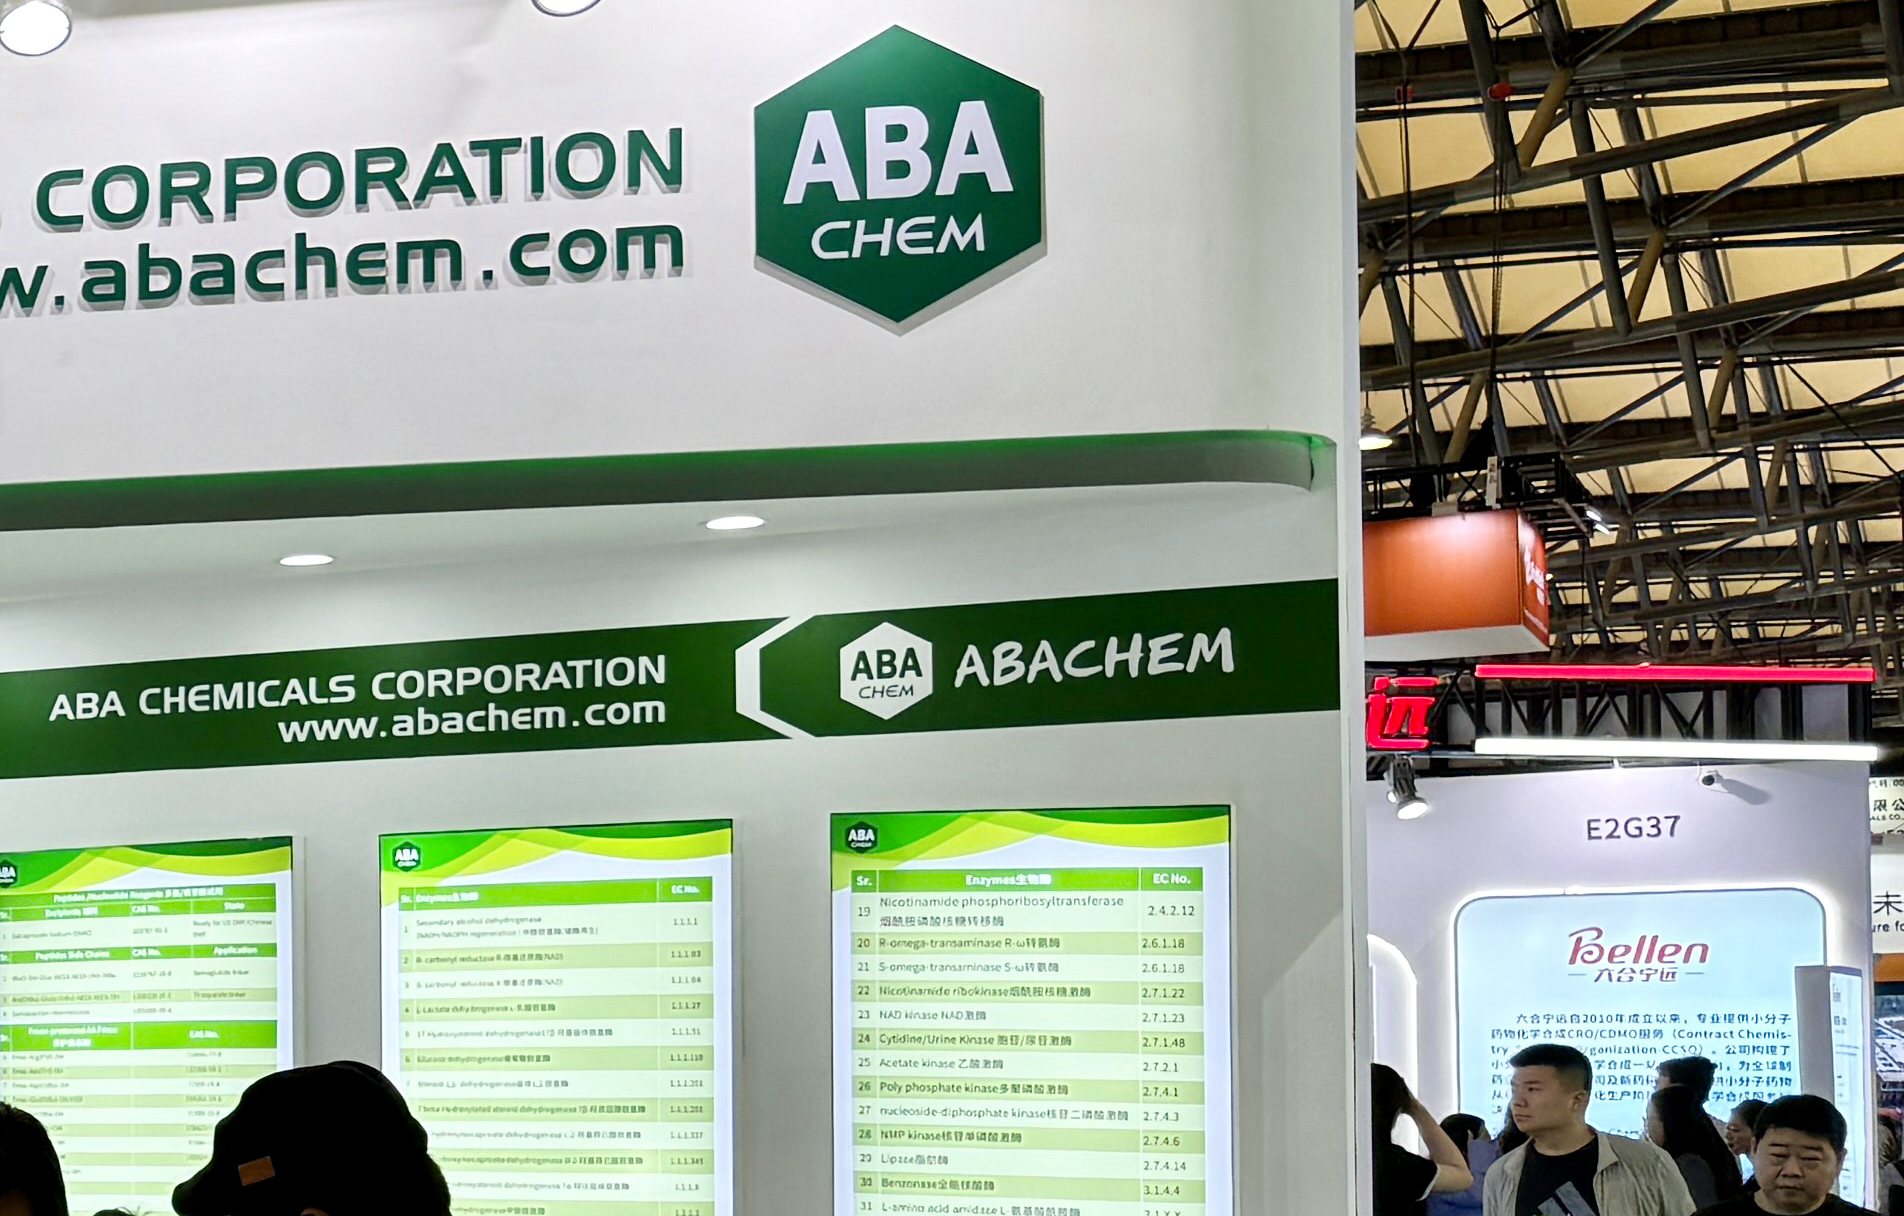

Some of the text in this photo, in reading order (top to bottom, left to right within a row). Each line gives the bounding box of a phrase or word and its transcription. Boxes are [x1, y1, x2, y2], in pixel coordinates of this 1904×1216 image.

[783, 100, 1013, 205] ABA
[35, 128, 684, 228] CORPORATION
[811, 212, 986, 261] CHEM
[851, 647, 923, 681] ABA
[954, 627, 1234, 688] ABACHEM
[49, 654, 666, 722] ABA CHEMICALS CORPORATION
[859, 684, 914, 699] CHEM
[278, 699, 666, 743] www.abachem.com
[848, 827, 875, 843] ABA
[1586, 815, 1681, 841] E2G37
[856, 875, 873, 886] Sr.
[1153, 873, 1168, 885] EC
[1170, 873, 1191, 885] No.
[857, 906, 871, 917] 19
[1147, 904, 1196, 917] 2.4.2.12
[1568, 926, 1709, 966] Bellen
[1594, 967, 1679, 983] 六合宁远
